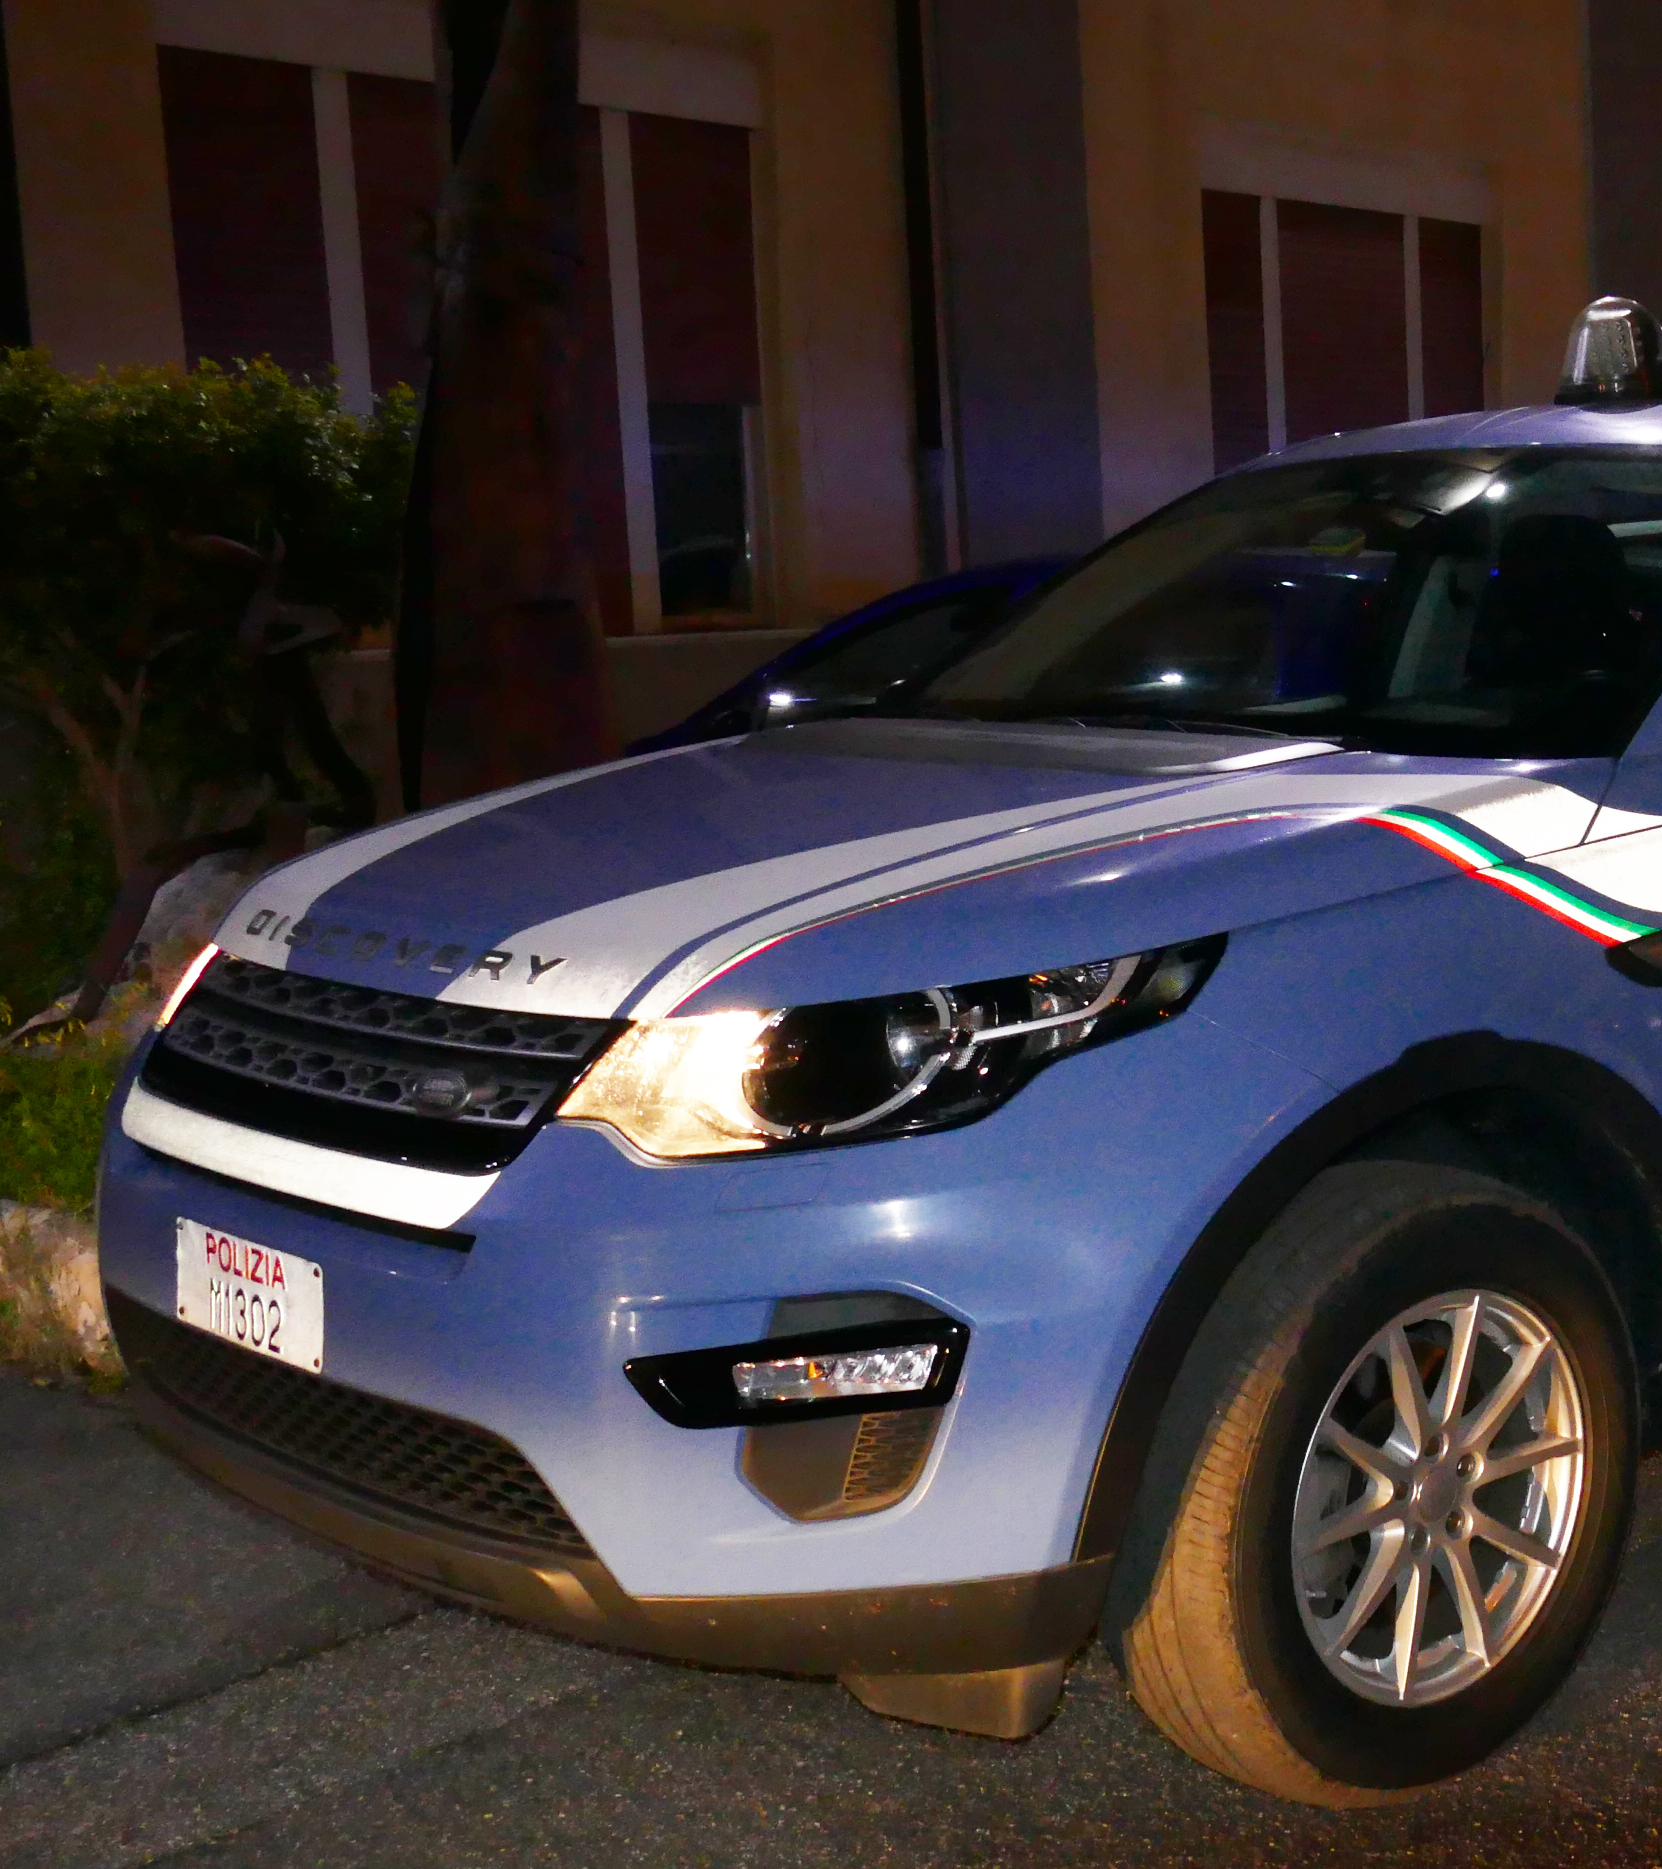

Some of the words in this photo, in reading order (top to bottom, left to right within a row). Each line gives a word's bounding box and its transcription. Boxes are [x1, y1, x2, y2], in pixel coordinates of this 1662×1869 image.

[246, 909, 569, 985] DISCOVERY
[206, 1232, 288, 1292] POLIZIA
[210, 1277, 284, 1355] M1302
